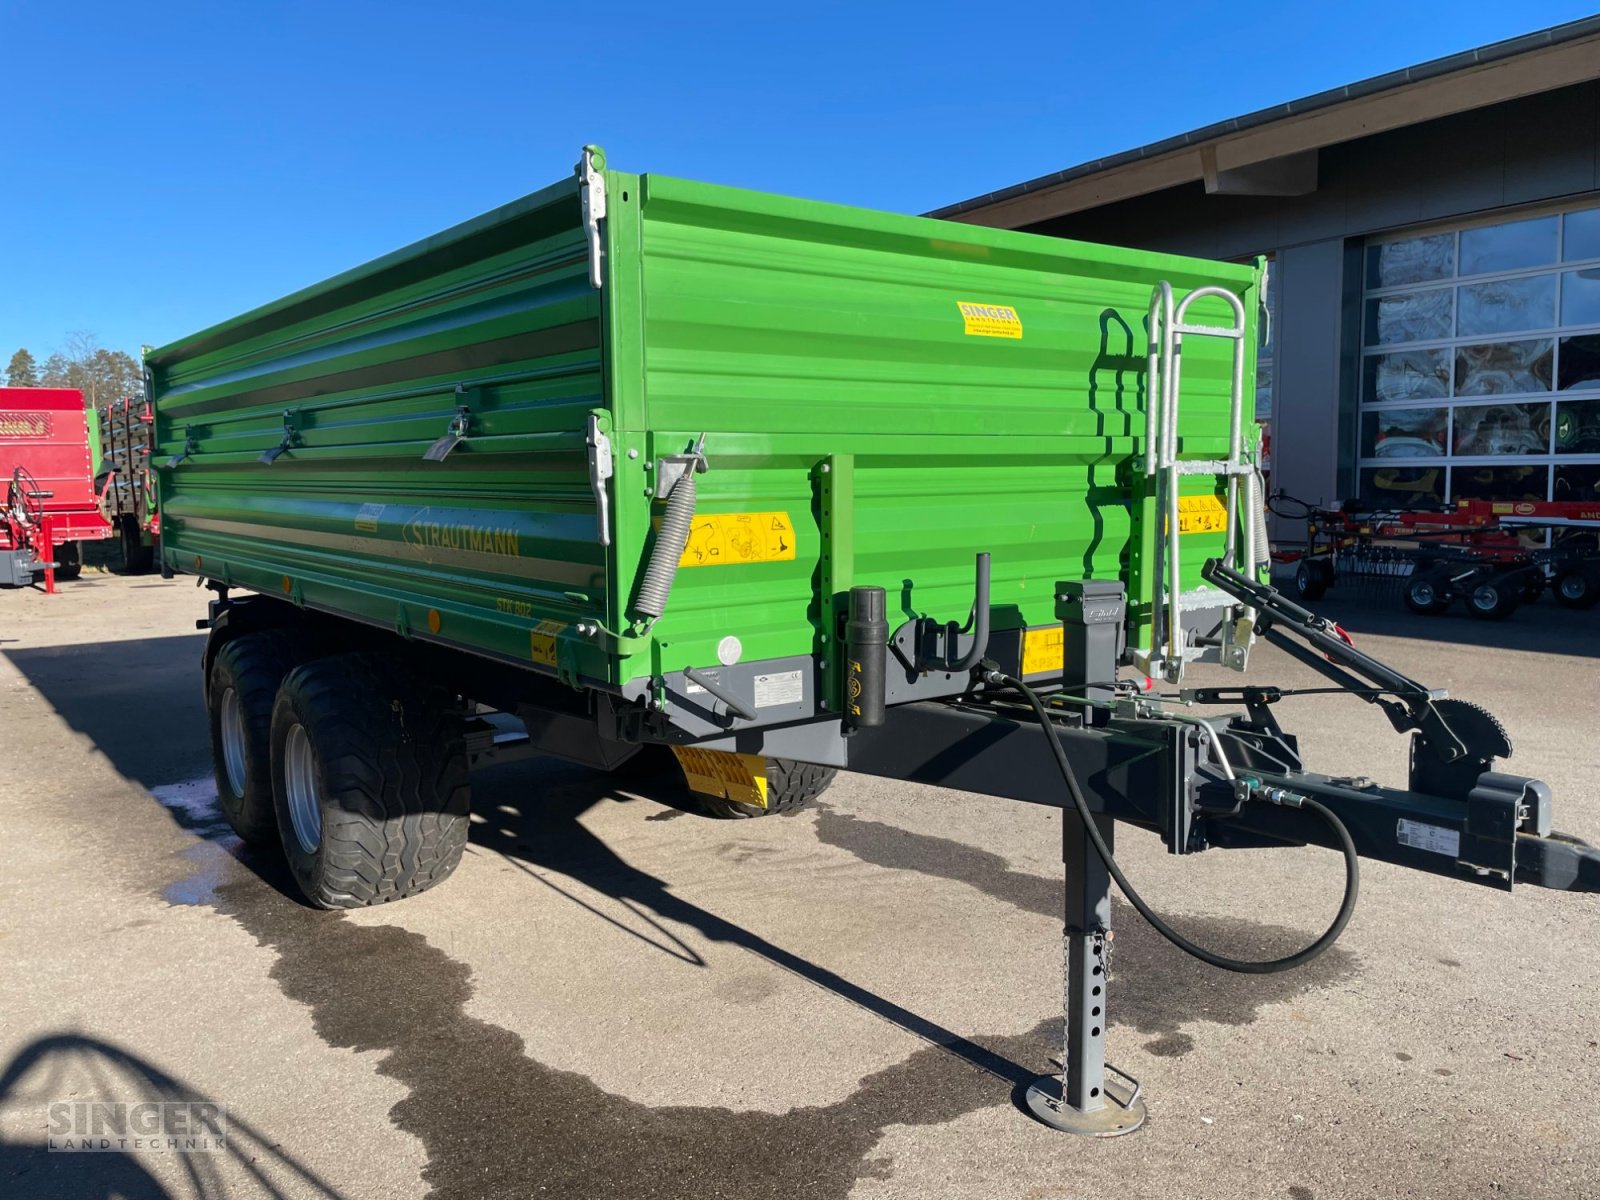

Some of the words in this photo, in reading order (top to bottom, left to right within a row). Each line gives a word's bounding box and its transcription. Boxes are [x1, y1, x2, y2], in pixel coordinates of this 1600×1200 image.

[961, 304, 1017, 320] SINGER
[412, 520, 520, 559] STRAUTMANN
[496, 597, 513, 614] STK
